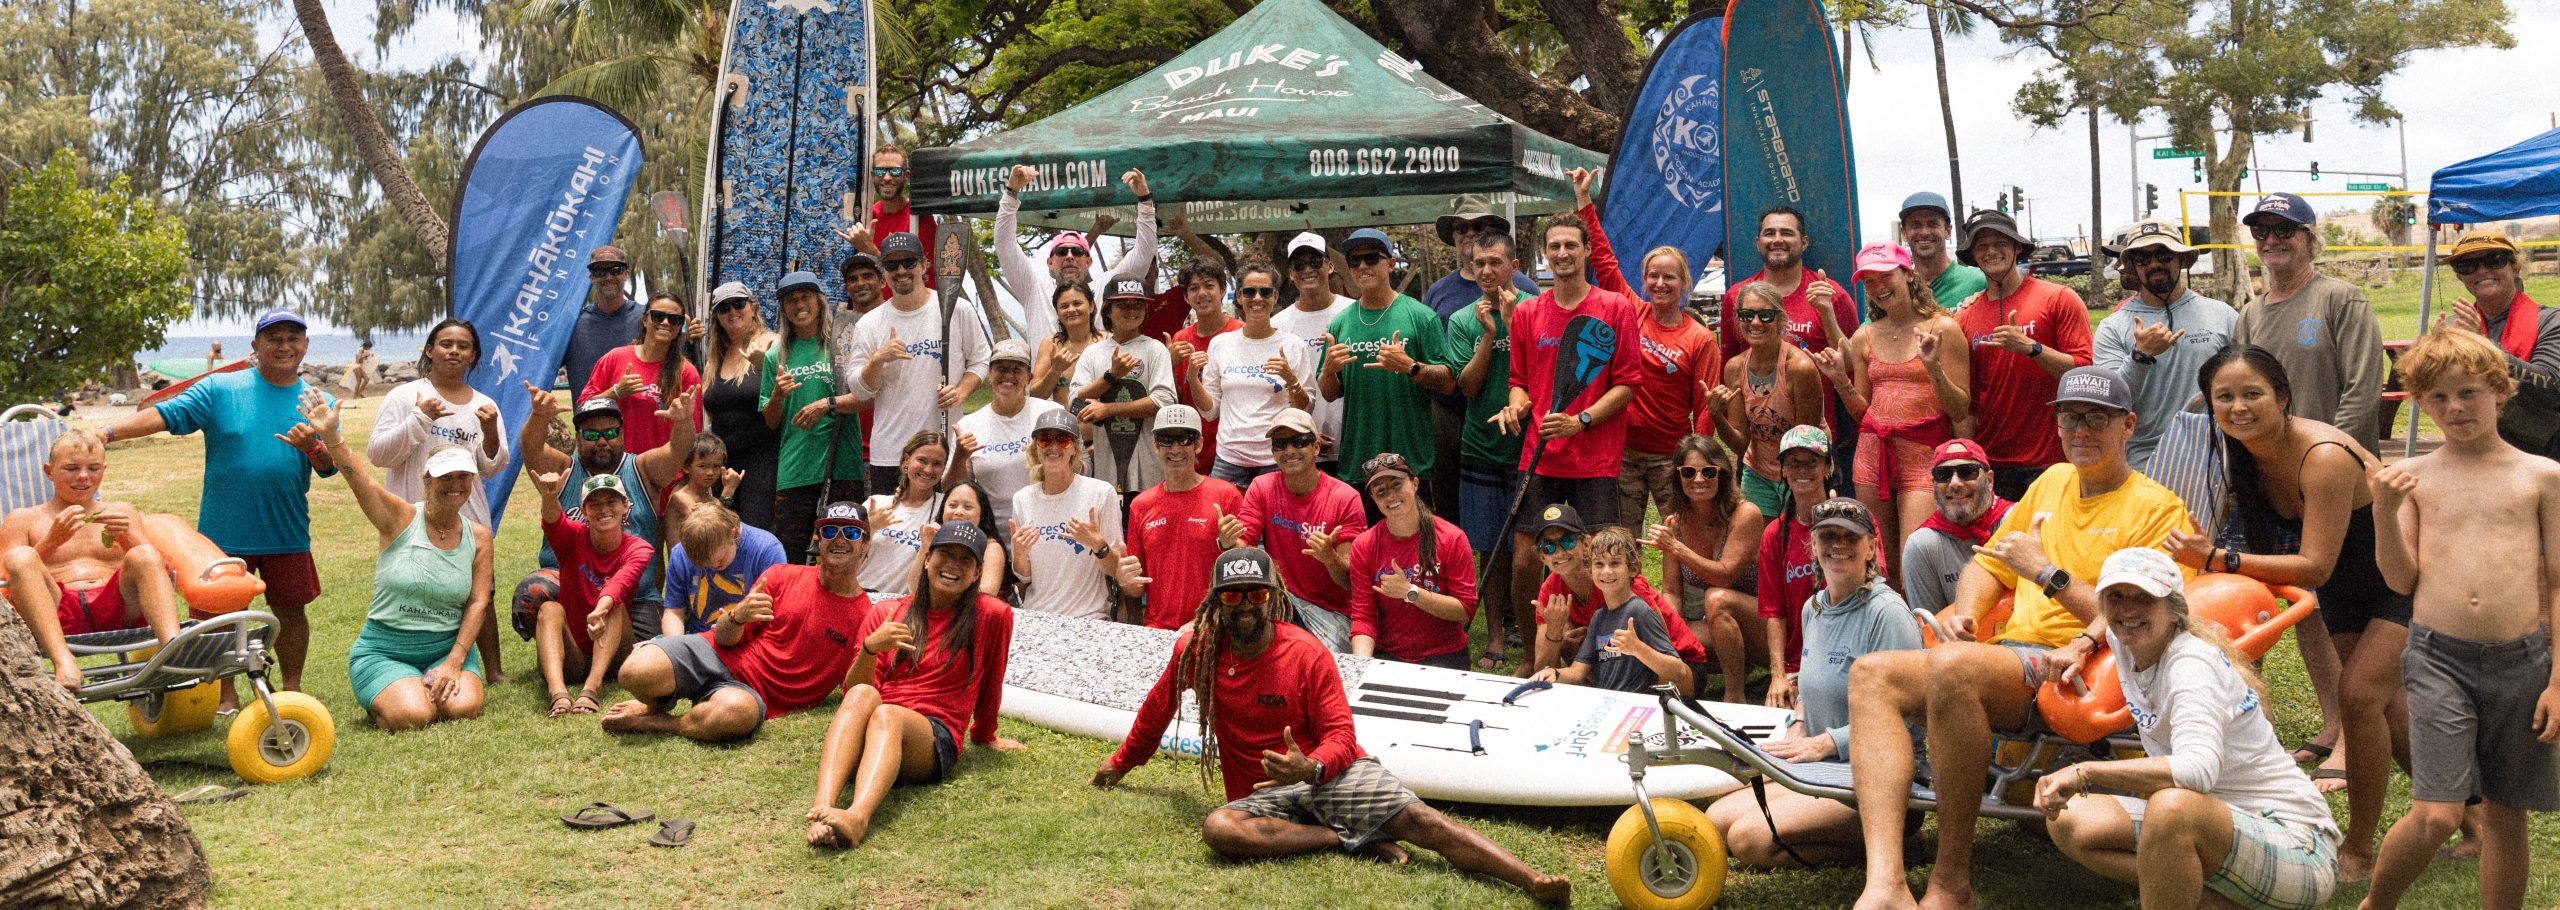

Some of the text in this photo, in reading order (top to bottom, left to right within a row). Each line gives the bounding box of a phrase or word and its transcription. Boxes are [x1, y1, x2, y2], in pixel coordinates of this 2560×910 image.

[1163, 43, 1350, 91] DUKE'S
[1129, 77, 1355, 113] Beach House
[1178, 107, 1260, 124] MAUI
[1672, 115, 1719, 156] KO
[1309, 146, 1460, 177] 808.662.2900
[1674, 153, 1694, 183] OCEAN
[950, 159, 1107, 197] DUKESAUI.COM
[528, 155, 621, 342] FOUNDATION
[1117, 280, 1144, 293] KOA
[1344, 337, 1409, 353] AccesSuf
[431, 425, 478, 442] ccesSurf
[827, 504, 859, 520] KOA
[1145, 517, 1167, 531] CRAIG
[1223, 559, 1264, 578] KOA
